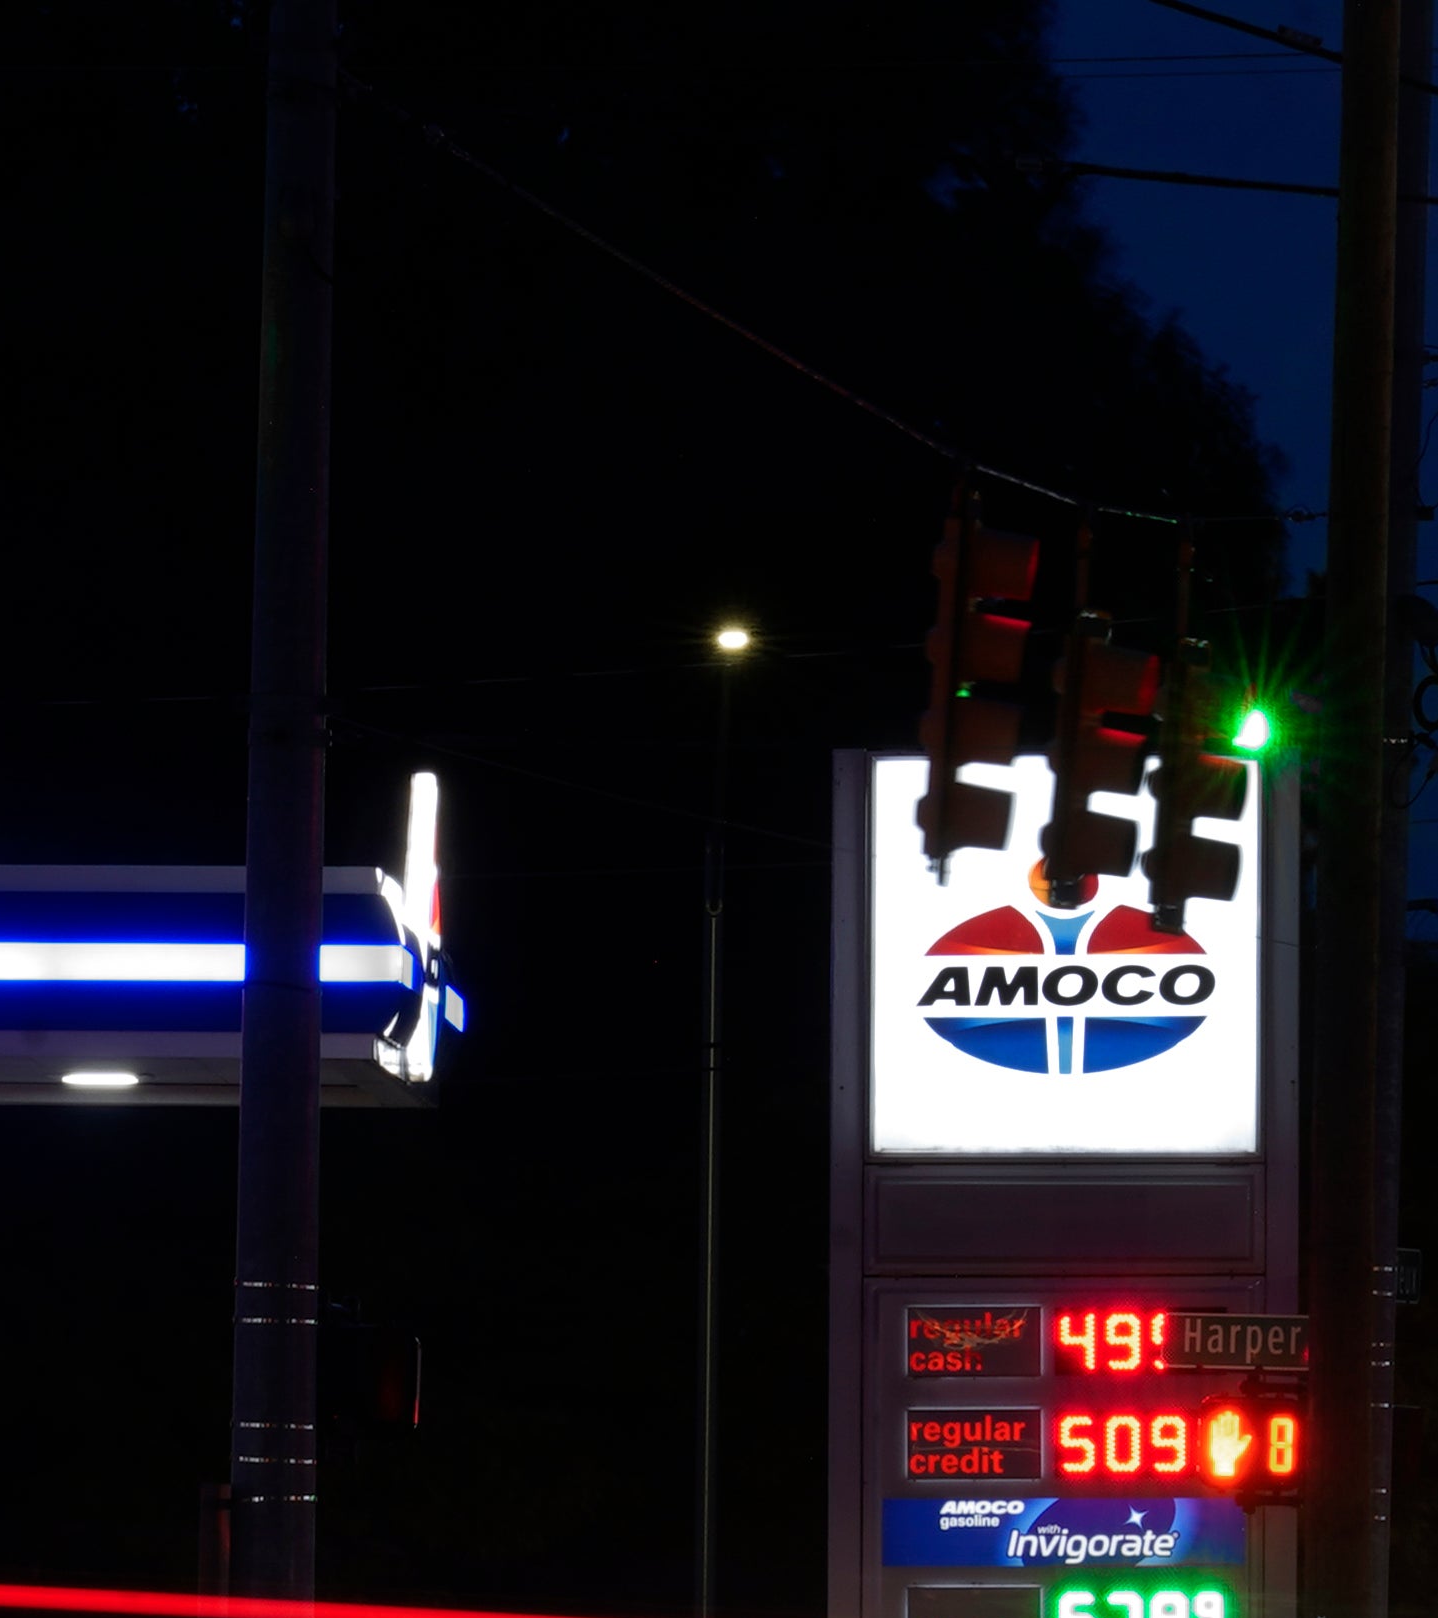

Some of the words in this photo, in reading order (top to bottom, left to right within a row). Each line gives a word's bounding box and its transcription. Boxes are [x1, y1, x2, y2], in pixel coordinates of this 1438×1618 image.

[917, 965, 1216, 1006] AMOCO
[910, 1312, 1025, 1344] regular
[1185, 1318, 1301, 1364] Harper
[910, 1415, 1026, 1448] regular
[910, 1447, 1004, 1473] credit
[940, 1500, 1024, 1514] AMOCO
[940, 1515, 999, 1530] gasoline
[1038, 1524, 1061, 1534] with
[1006, 1528, 1175, 1563] Invigorate
